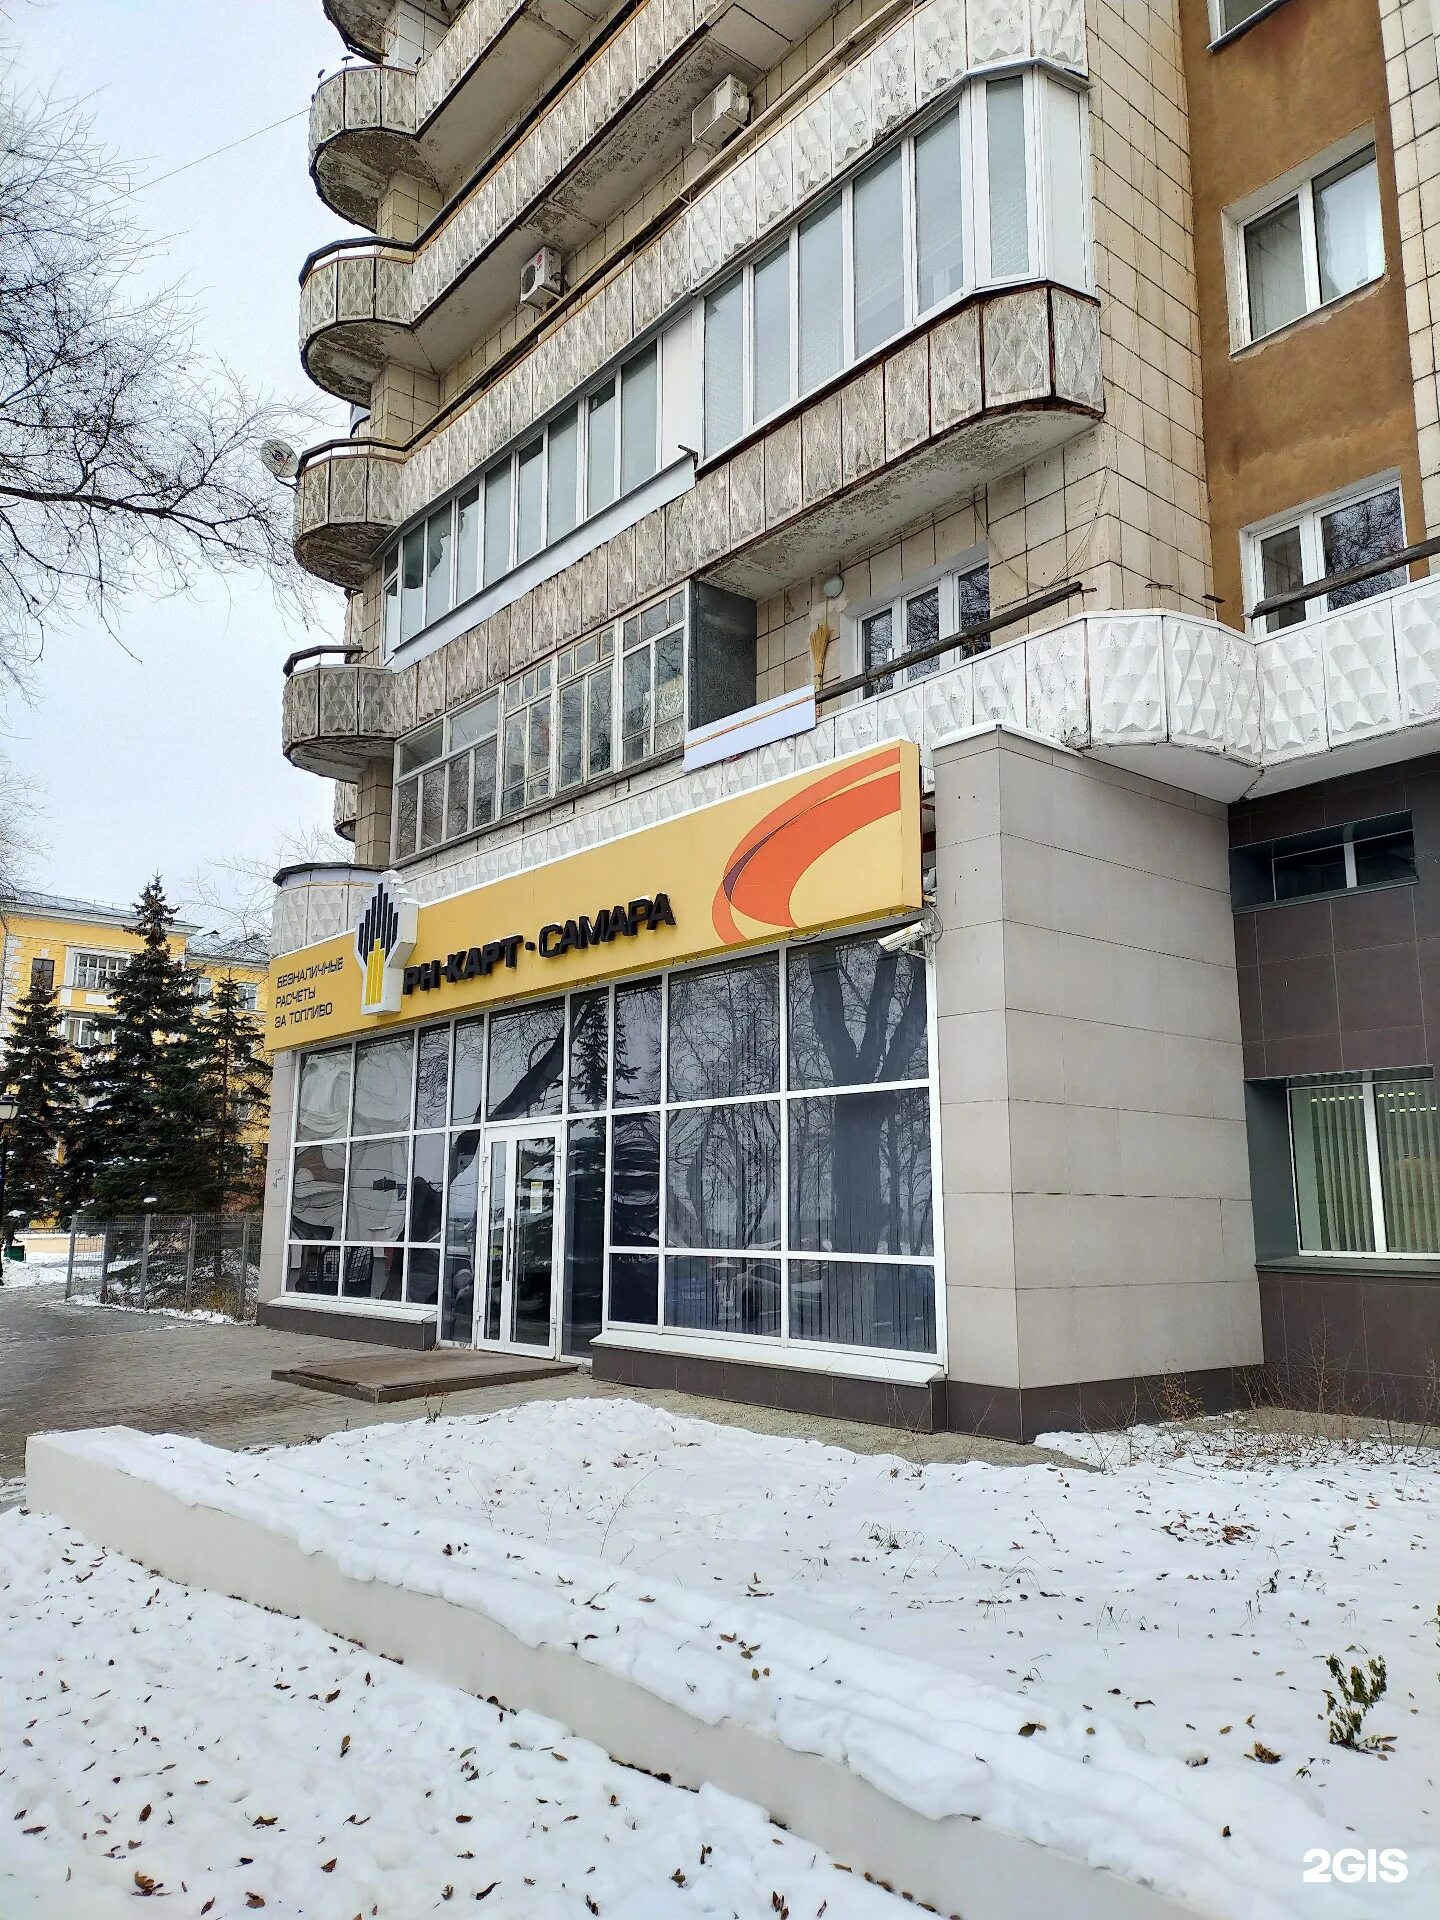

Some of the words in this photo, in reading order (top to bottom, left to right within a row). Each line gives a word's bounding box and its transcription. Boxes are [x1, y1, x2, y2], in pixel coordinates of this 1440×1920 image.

[538, 892, 676, 958] САМАРА
[276, 956, 344, 989] БЕЗНАЛИЧНЫЕ
[275, 985, 316, 1009] РАСЧЕТЫ
[274, 1014, 287, 1029] ЗА
[289, 1001, 333, 1025] ТОПЛИВО
